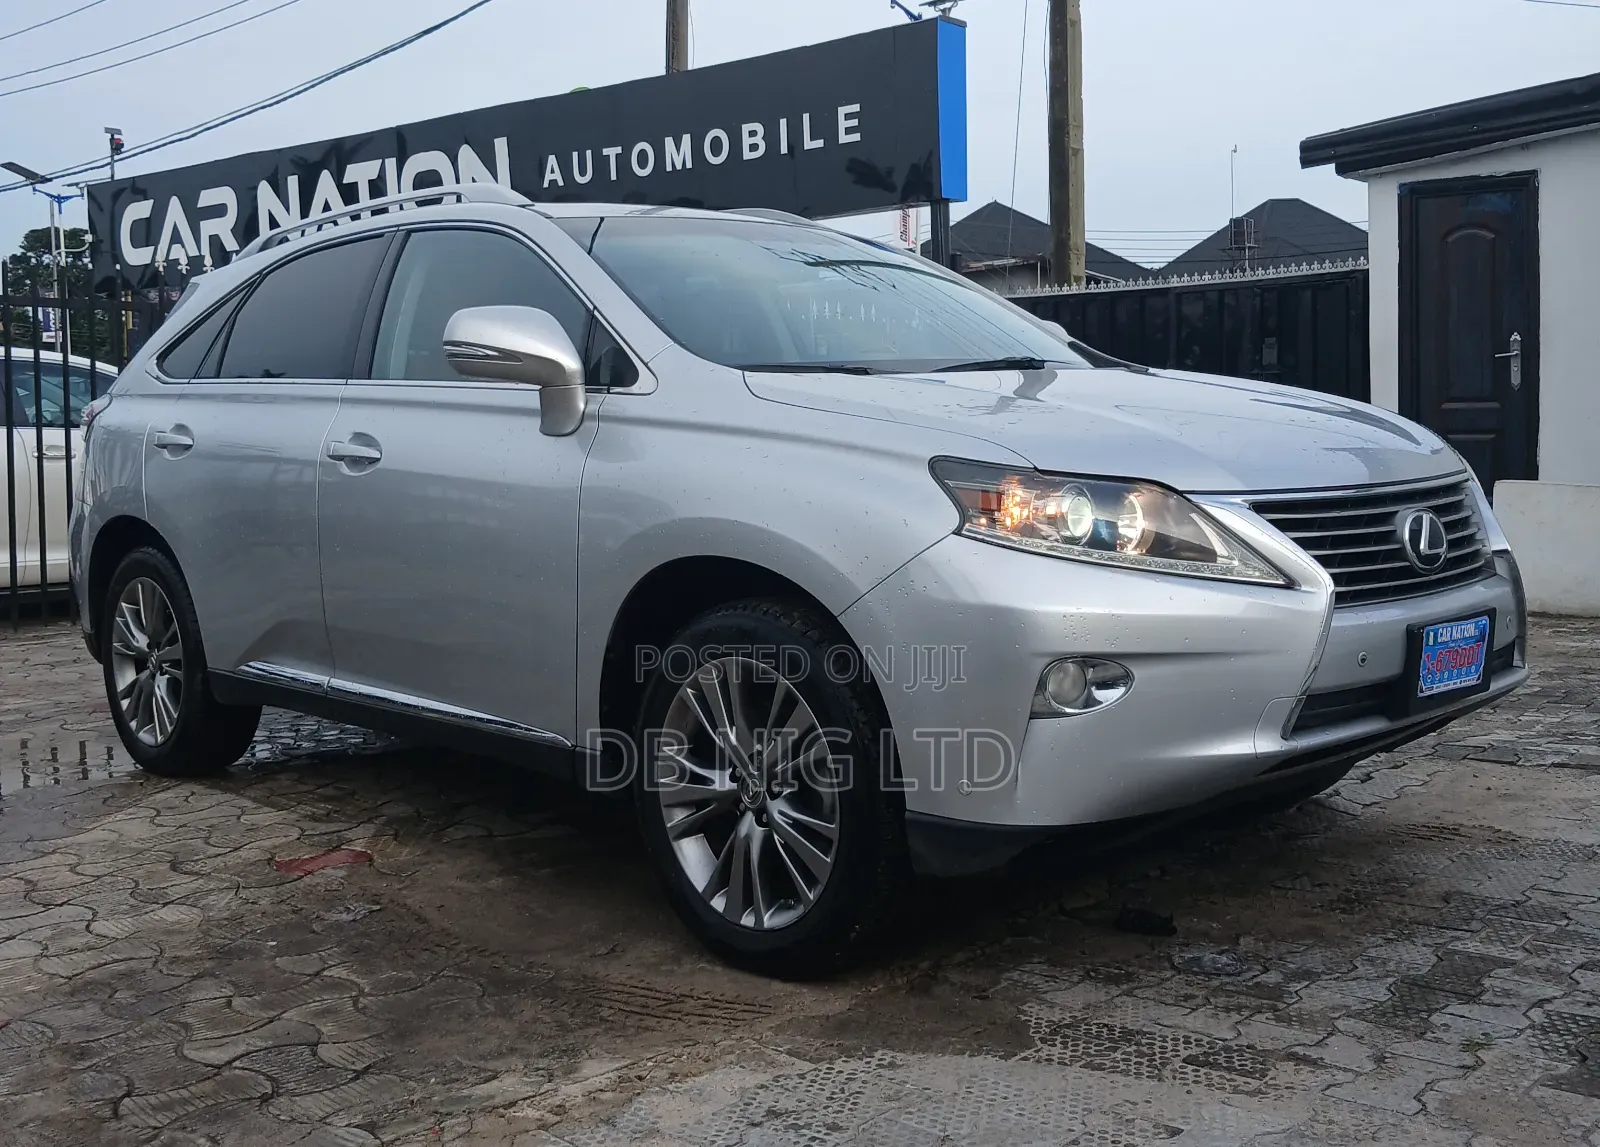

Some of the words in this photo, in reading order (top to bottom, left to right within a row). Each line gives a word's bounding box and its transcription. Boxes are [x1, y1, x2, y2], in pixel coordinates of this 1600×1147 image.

[542, 103, 861, 188] AUTOMOBILE
[120, 185, 240, 266] CAR
[257, 136, 511, 241] NATION
[1438, 627, 1451, 643] CAR
[1451, 622, 1475, 640] NATION
